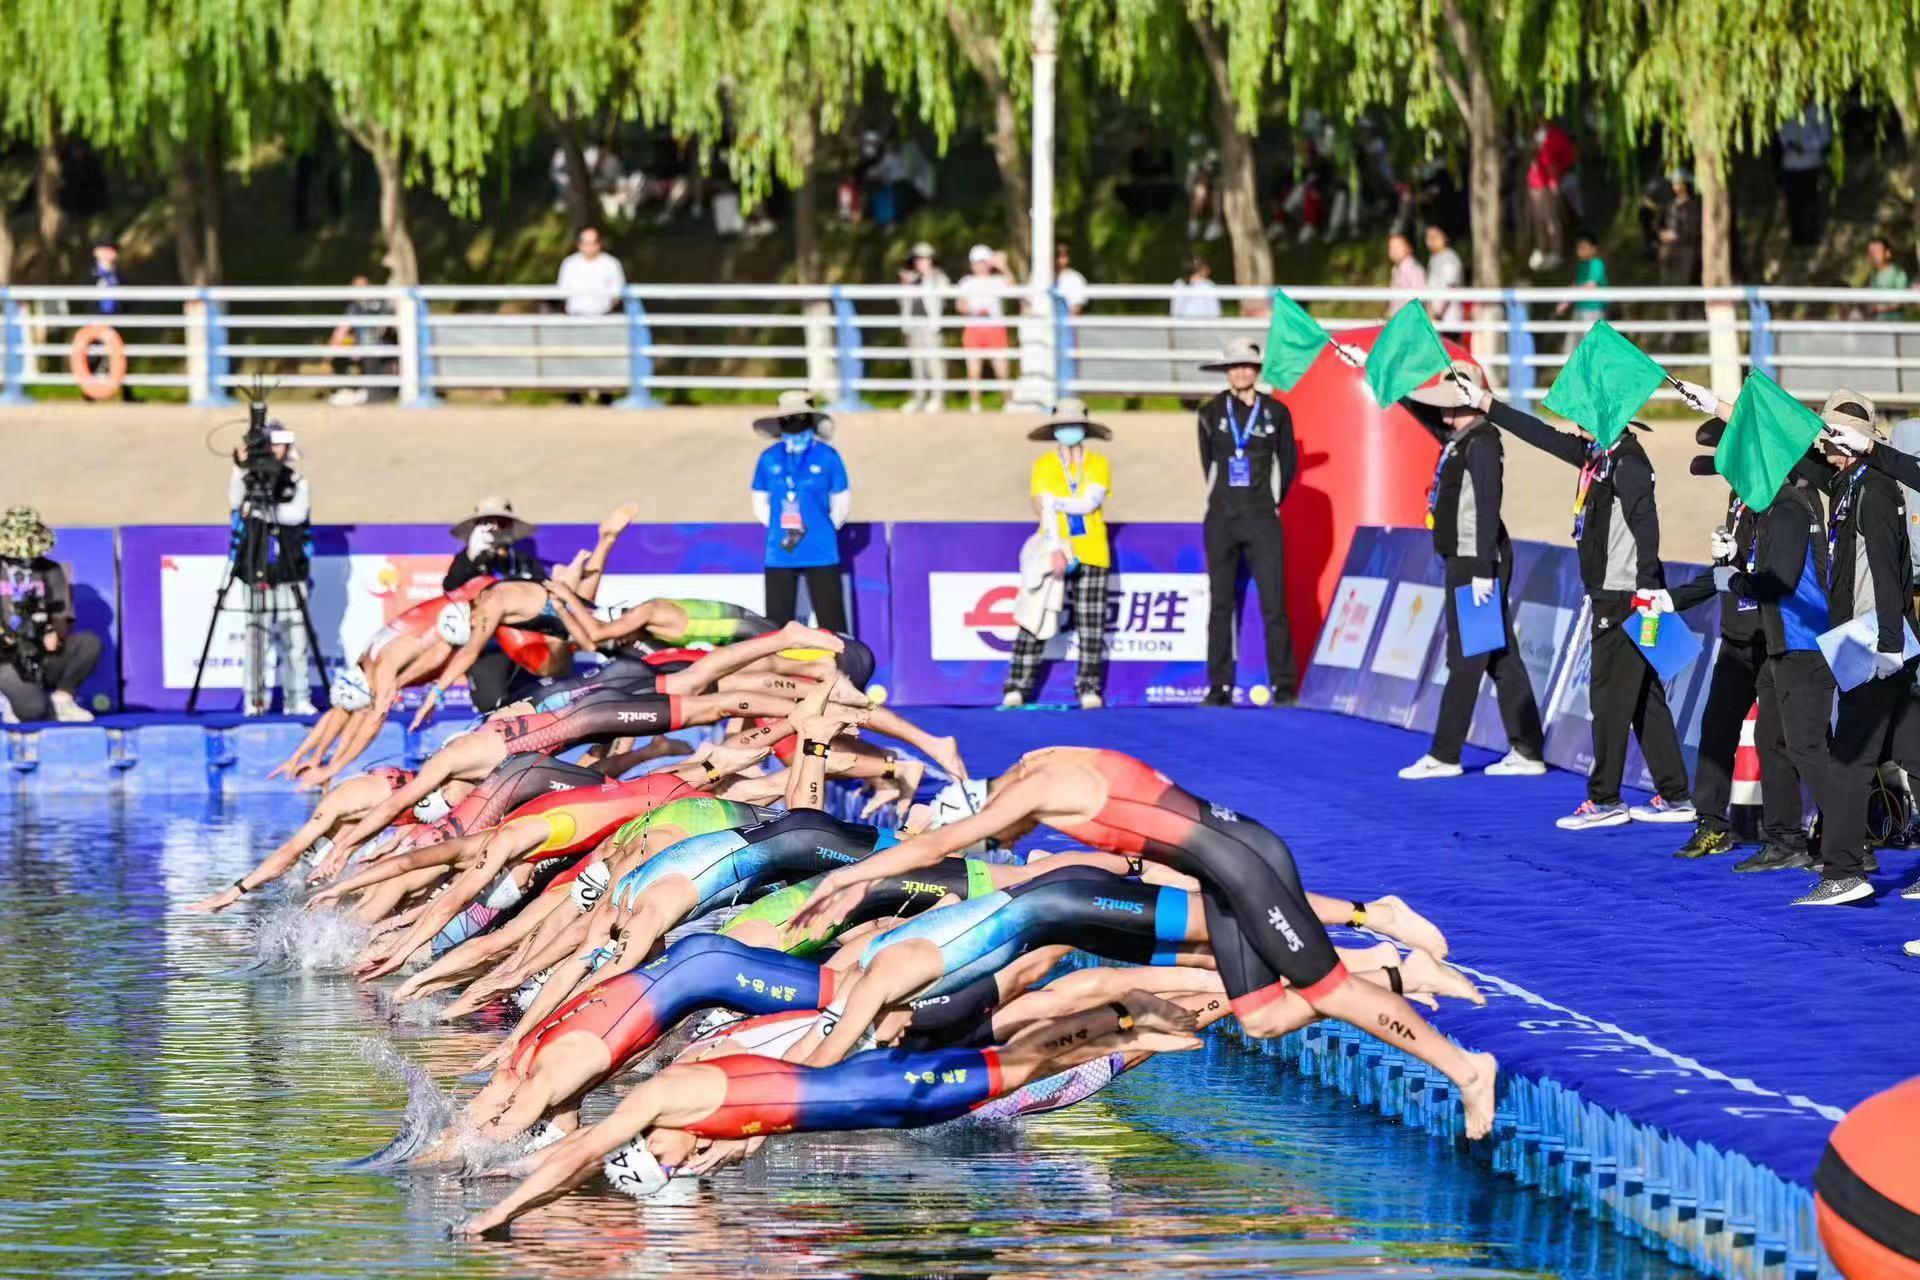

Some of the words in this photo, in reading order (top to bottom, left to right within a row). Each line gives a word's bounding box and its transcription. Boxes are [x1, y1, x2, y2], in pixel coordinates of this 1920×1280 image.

[617, 711, 657, 723] Santic
[901, 880, 948, 898] Santic
[1092, 896, 1145, 915] Santic
[1268, 904, 1305, 953] Santic
[610, 1150, 643, 1187] 24
